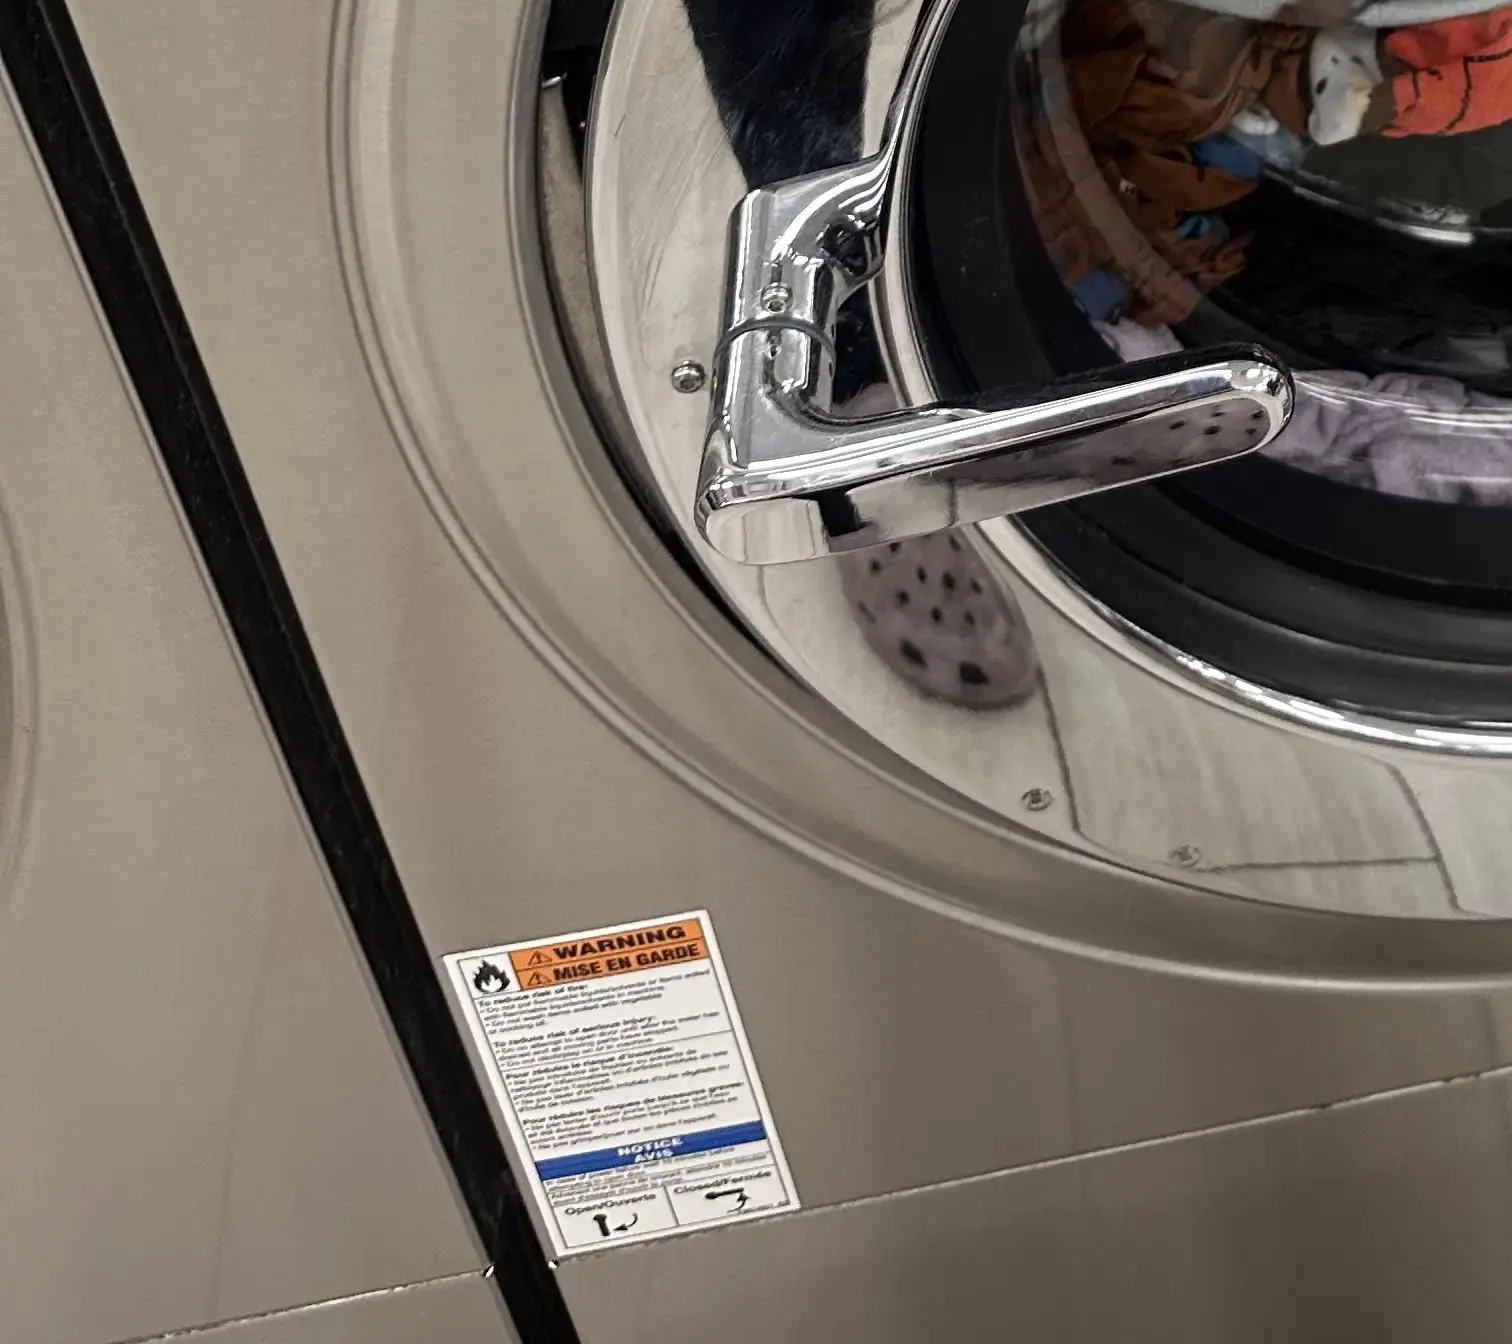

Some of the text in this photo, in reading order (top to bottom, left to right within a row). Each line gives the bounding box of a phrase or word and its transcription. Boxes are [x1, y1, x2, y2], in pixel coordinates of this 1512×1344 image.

[553, 925, 686, 960] WARNING
[551, 943, 701, 981] MISE EN GARDE
[616, 1137, 683, 1156] NOTICE
[632, 1148, 673, 1164] AVIS
